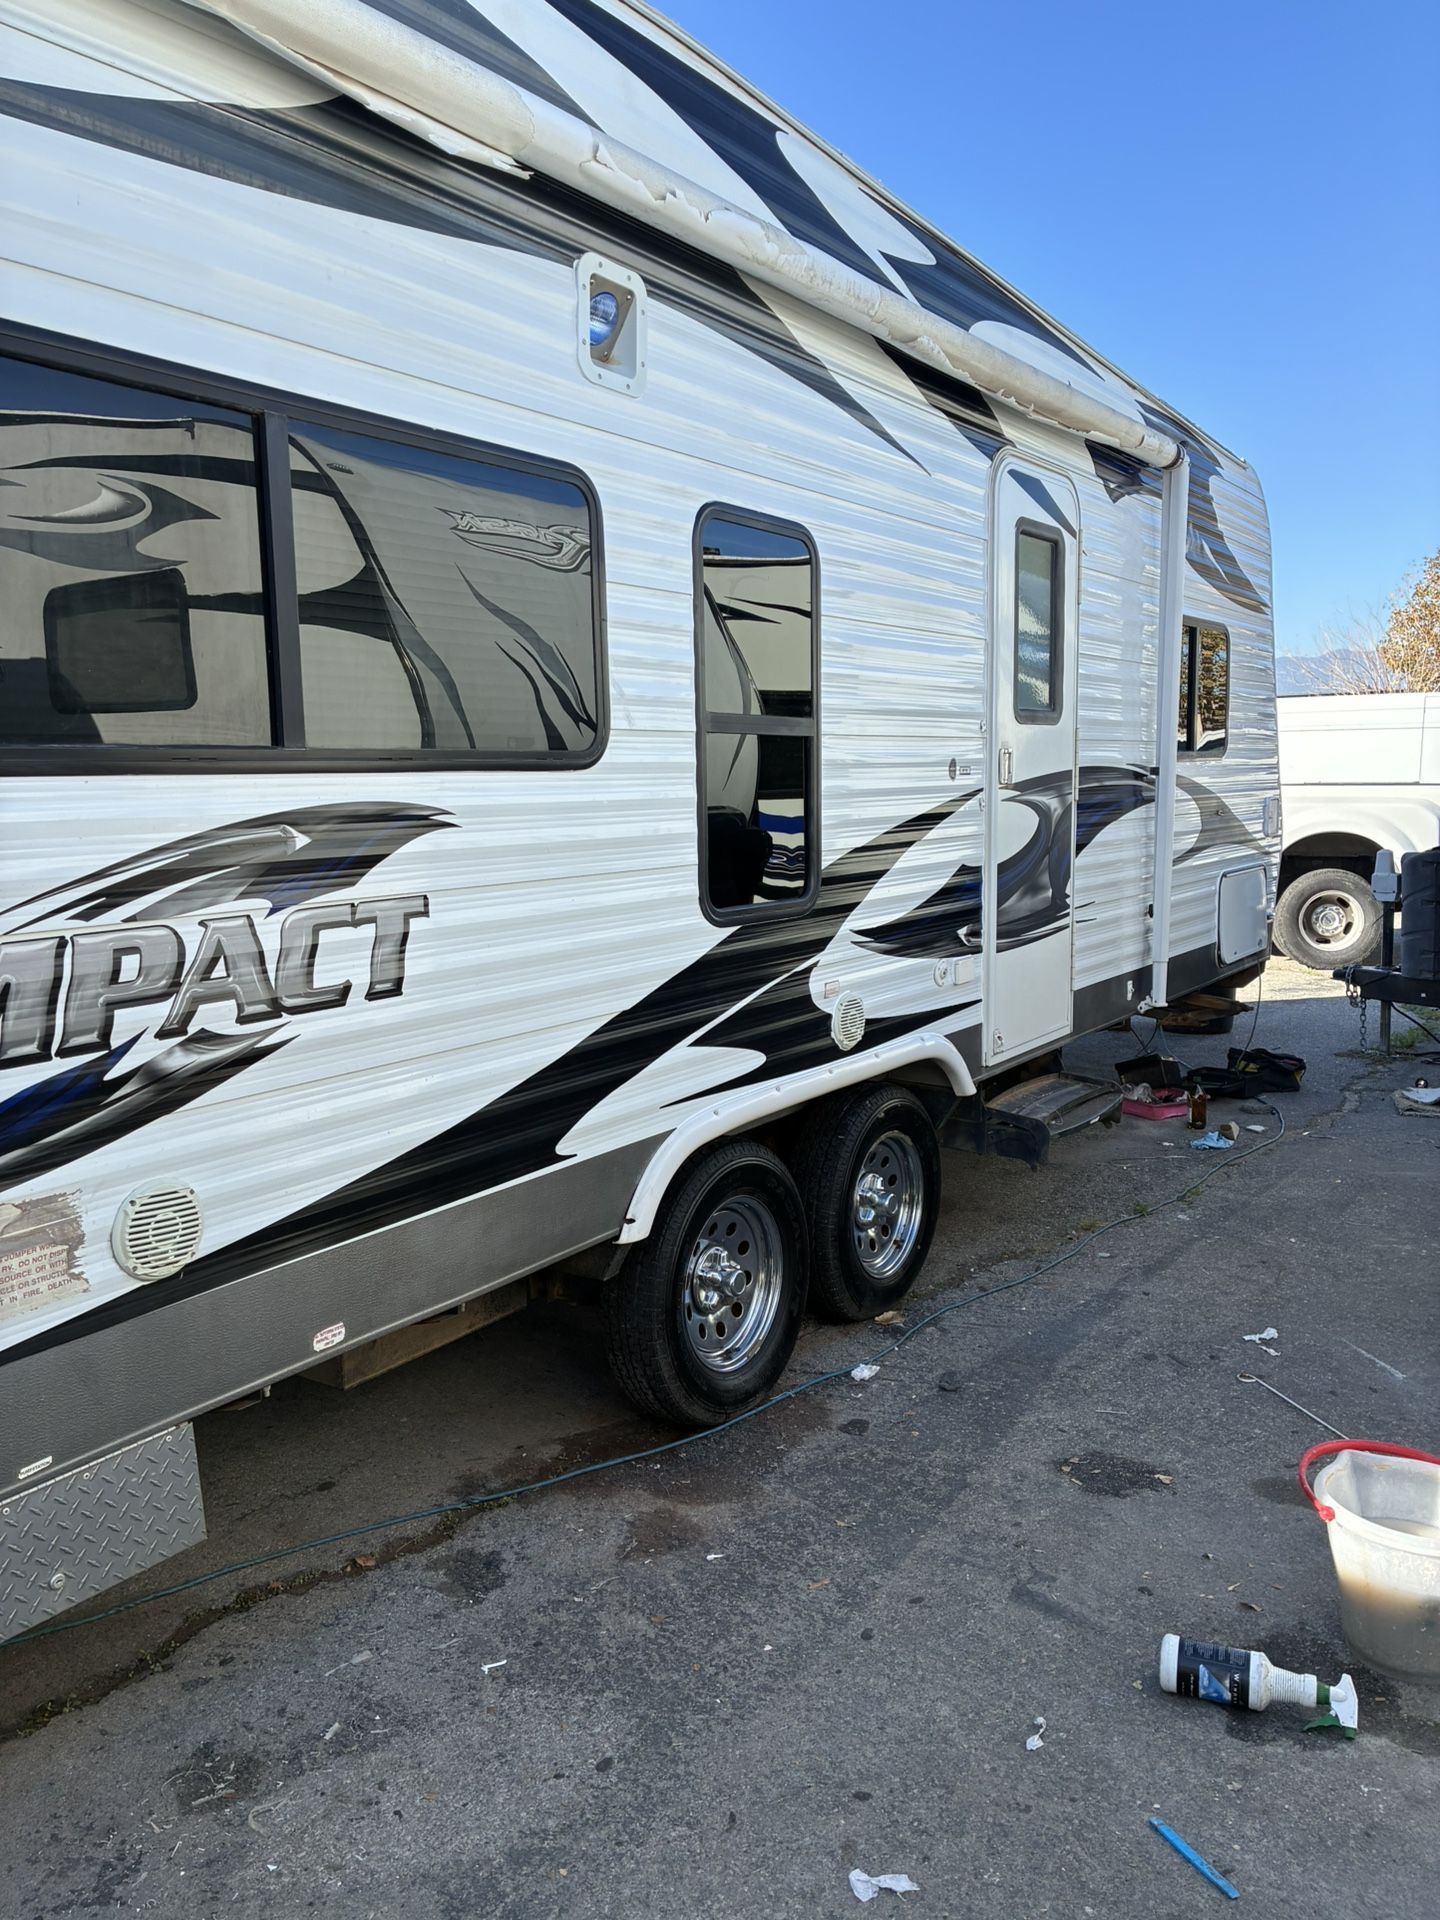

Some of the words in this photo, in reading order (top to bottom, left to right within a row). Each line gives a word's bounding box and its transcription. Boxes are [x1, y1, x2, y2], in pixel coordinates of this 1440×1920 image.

[4, 1246, 37, 1262] JUMPER
[18, 1259, 30, 1268] DO
[32, 1253, 47, 1264] NOT
[35, 1264, 46, 1274] OR
[18, 1280, 30, 1290] OR
[31, 1270, 67, 1286] STRUCTU
[9, 1295, 18, 1303] IN
[47, 1278, 72, 1291] DEATH
